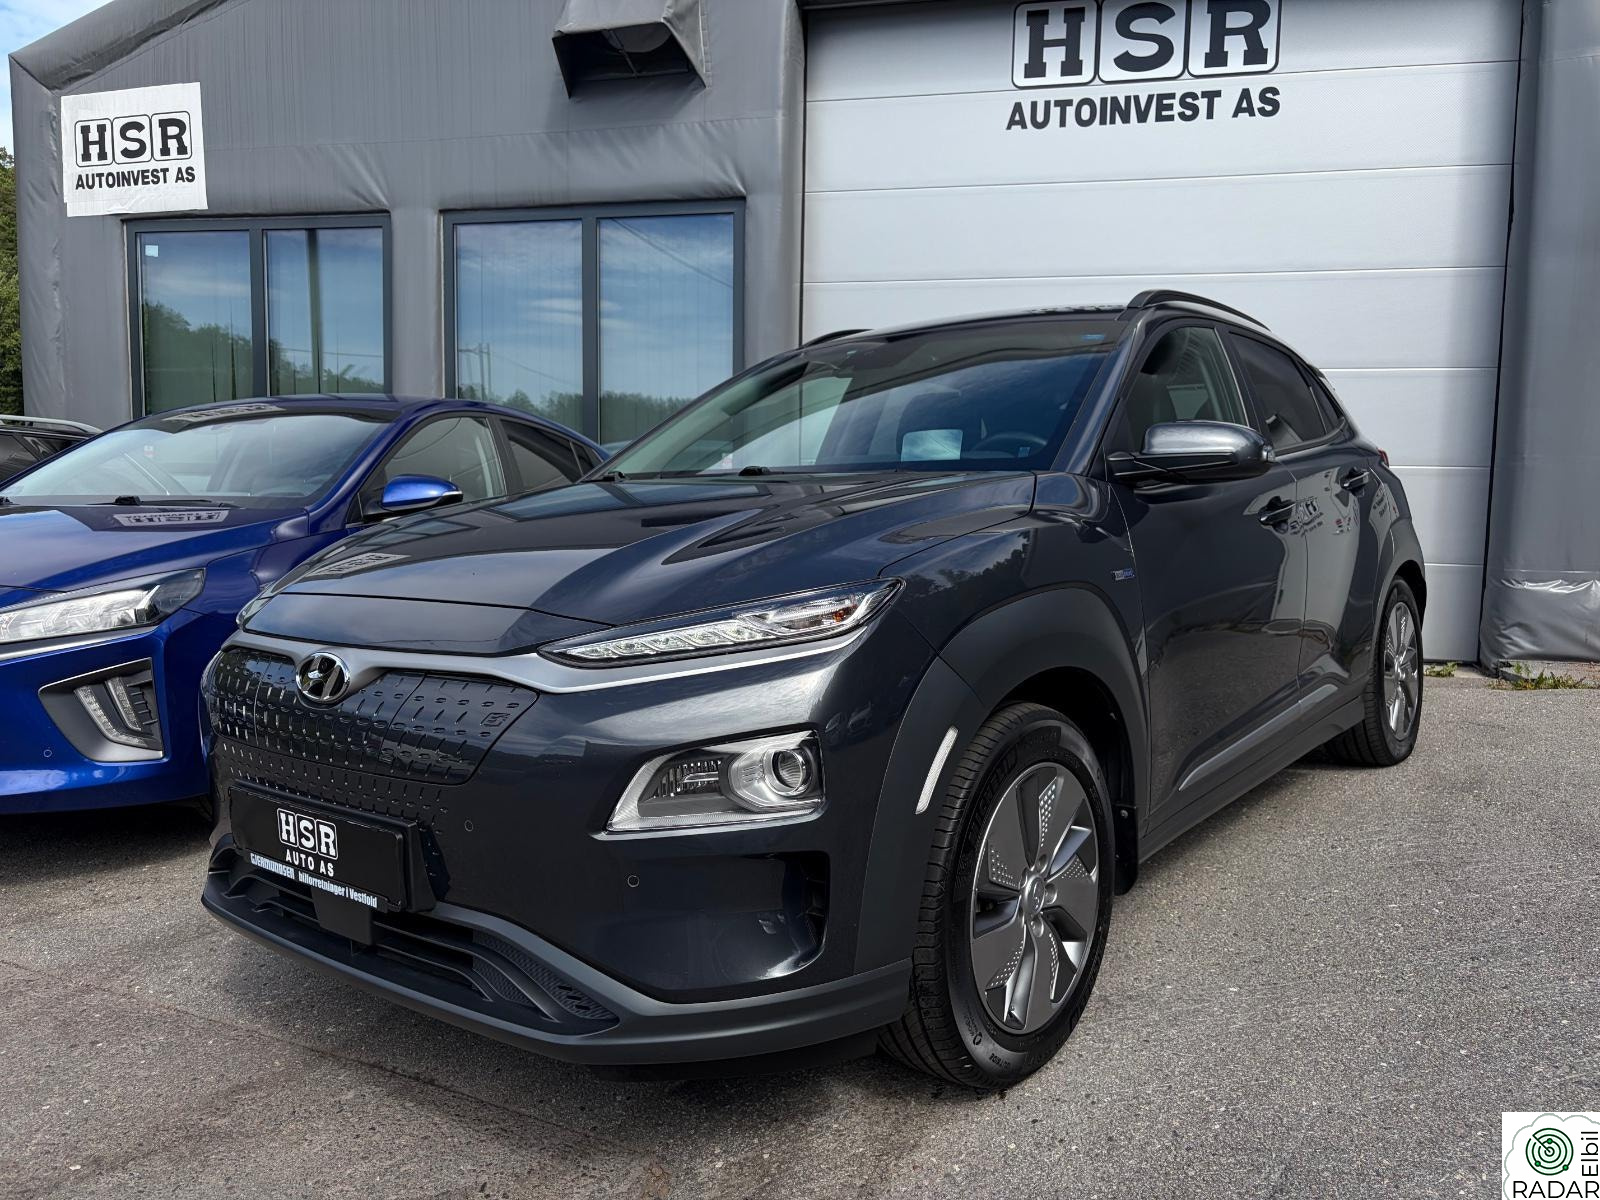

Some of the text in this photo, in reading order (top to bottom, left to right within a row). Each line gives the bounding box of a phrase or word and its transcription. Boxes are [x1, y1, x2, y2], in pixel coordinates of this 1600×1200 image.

[1023, 0, 1271, 79] HSR
[1005, 86, 1281, 131] AUTOINVEST AS
[80, 118, 189, 162] HSR
[75, 166, 196, 190] AUTOINVEST AS
[279, 812, 337, 857] HSR
[285, 849, 335, 877] AUTO AS
